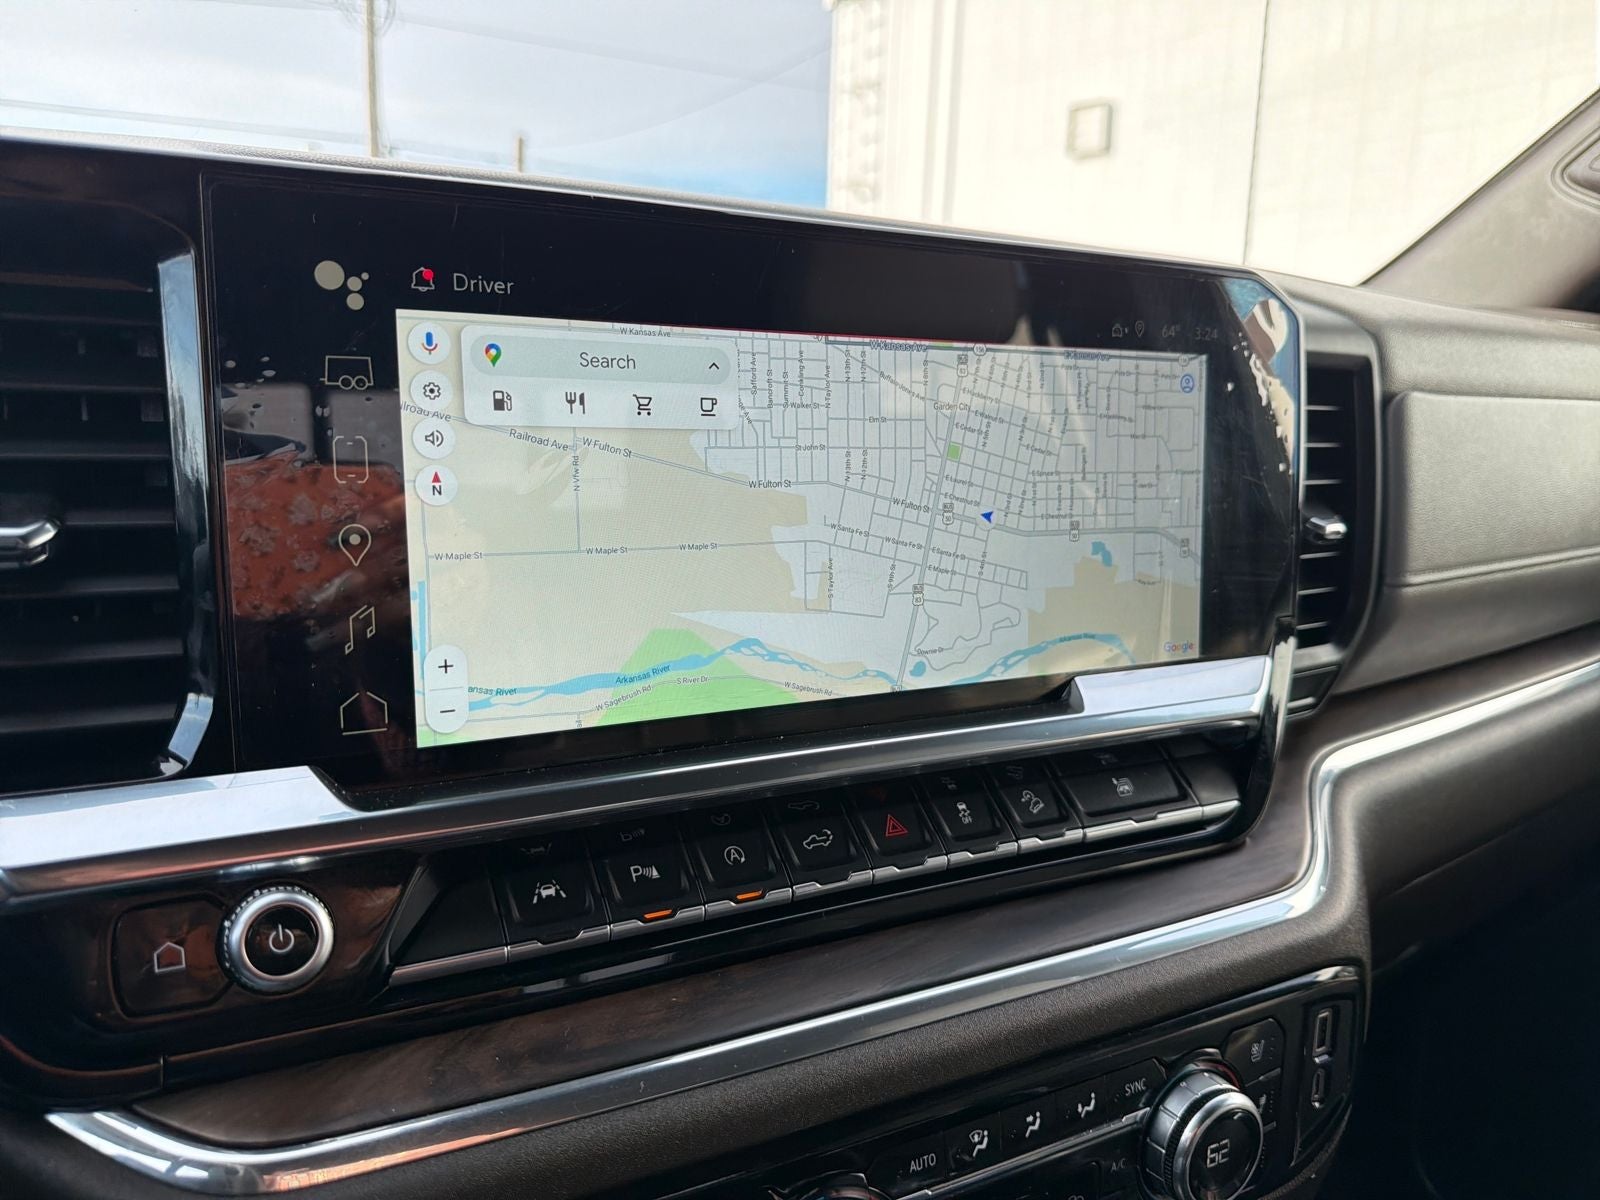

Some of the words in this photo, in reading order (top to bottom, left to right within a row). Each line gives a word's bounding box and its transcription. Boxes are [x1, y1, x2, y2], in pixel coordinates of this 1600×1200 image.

[453, 273, 514, 295] Driver
[620, 327, 628, 335] W
[629, 328, 656, 337] Kansas
[658, 329, 672, 338] Ave
[1195, 328, 1218, 340] 3:24
[870, 340, 878, 350] W
[880, 341, 910, 352] Kansas
[911, 342, 928, 352] Ave
[579, 352, 636, 370] Search
[782, 371, 788, 379] St
[934, 402, 958, 411] Garden
[958, 402, 971, 412] City
[432, 411, 451, 422] Ave
[509, 428, 550, 448] Railroad
[550, 440, 568, 452] Ave
[582, 436, 592, 446] W
[594, 440, 622, 456] Fulton
[622, 448, 632, 458] St
[572, 455, 580, 466] Rd
[432, 484, 442, 496] N
[758, 480, 782, 488] Fulton
[900, 499, 922, 512] Fulton
[922, 504, 930, 513] St
[949, 494, 972, 506] Chestnut
[837, 524, 854, 534] Santa
[855, 528, 862, 536] Fe
[688, 543, 708, 552] Maple
[892, 538, 908, 548] Santa
[445, 552, 472, 562] Maple
[474, 552, 482, 560] St
[595, 547, 617, 555] Maple
[932, 566, 950, 575] Maple
[1164, 640, 1196, 654] Google
[615, 672, 651, 686] Arkansas
[652, 664, 671, 676] River
[496, 688, 518, 696] River
[792, 682, 824, 694] Sagebrush
[595, 704, 604, 712] W
[604, 689, 642, 708] Sagebrush
[642, 684, 652, 692] Rd
[1124, 1078, 1147, 1096] SYNC
[1206, 1138, 1230, 1169] 62
[910, 1153, 937, 1174] AUTO
[1110, 1158, 1127, 1174] A/C
